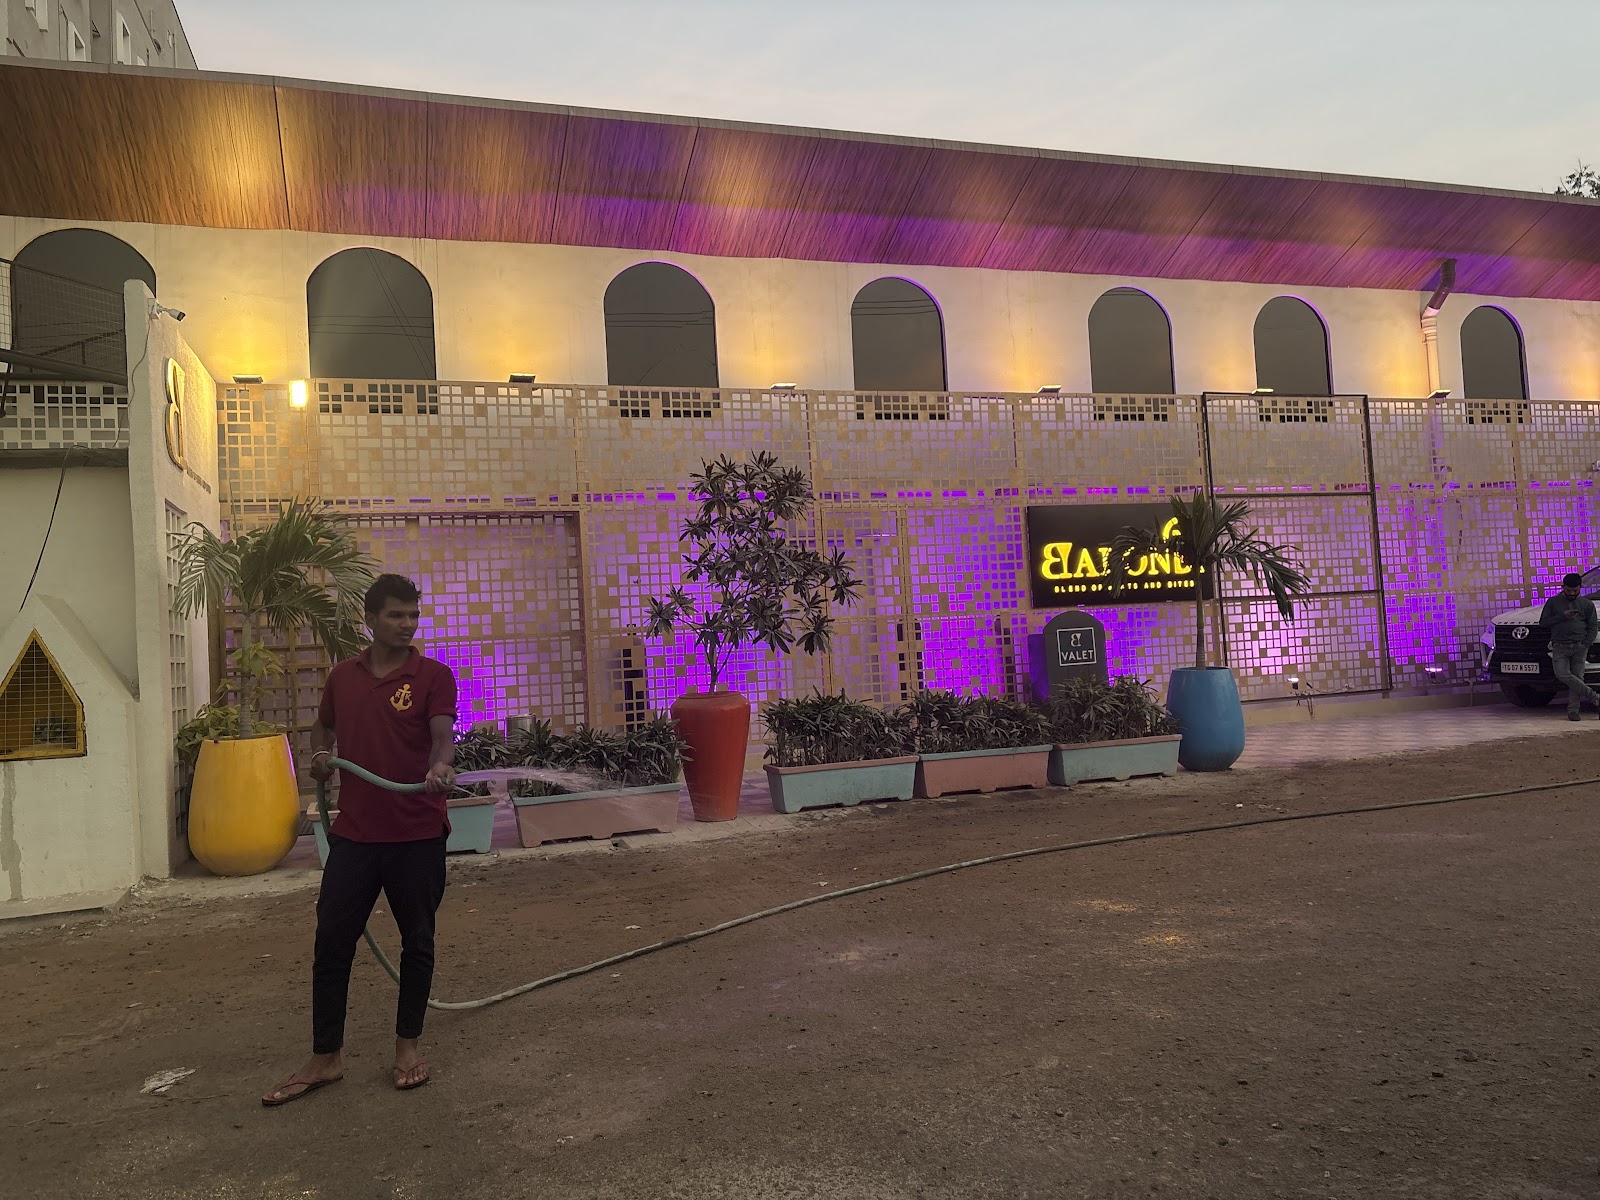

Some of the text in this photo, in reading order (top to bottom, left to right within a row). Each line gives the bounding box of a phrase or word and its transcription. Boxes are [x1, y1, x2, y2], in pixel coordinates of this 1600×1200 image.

[1054, 584, 1087, 593] BLEND
[1091, 583, 1103, 592] OF
[1143, 581, 1162, 590] AND
[1167, 579, 1195, 589] BITES
[1061, 649, 1094, 661] VALET
